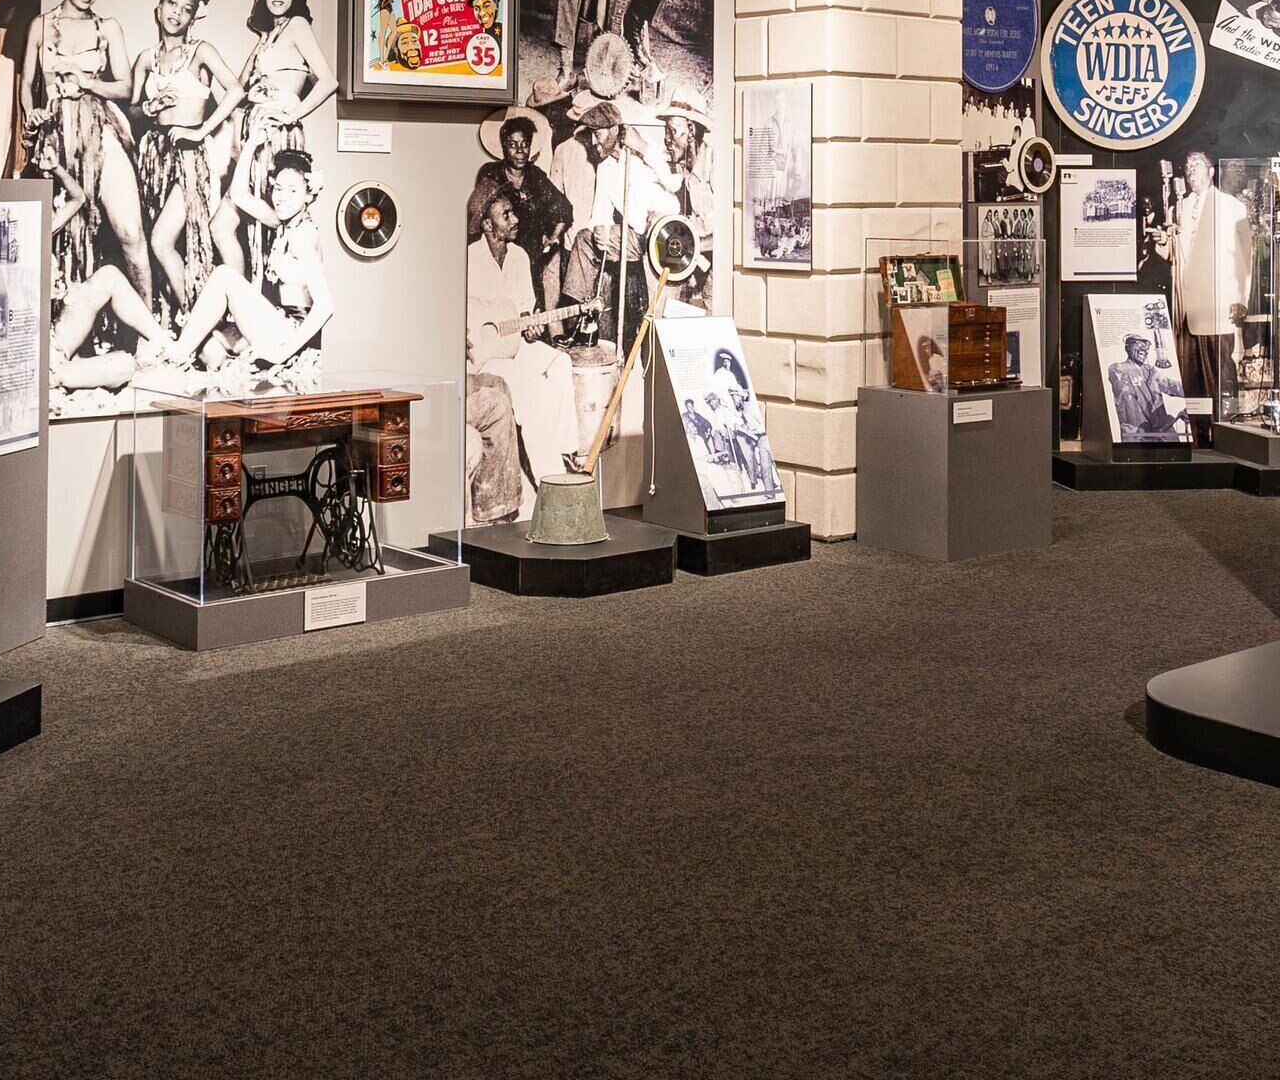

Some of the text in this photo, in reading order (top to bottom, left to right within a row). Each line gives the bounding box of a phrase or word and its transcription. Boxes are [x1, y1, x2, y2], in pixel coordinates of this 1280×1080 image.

[422, 28, 438, 47] 12
[1216, 14, 1240, 35] And
[1241, 26, 1257, 42] the
[429, 47, 461, 58] RED HOT
[470, 45, 496, 67] 35
[1232, 37, 1262, 56] Radio
[424, 53, 465, 65] STAGE BAND
[1082, 41, 1164, 83] WDIA
[1073, 91, 1179, 139] SINGERS
[251, 478, 306, 497] SINGER
